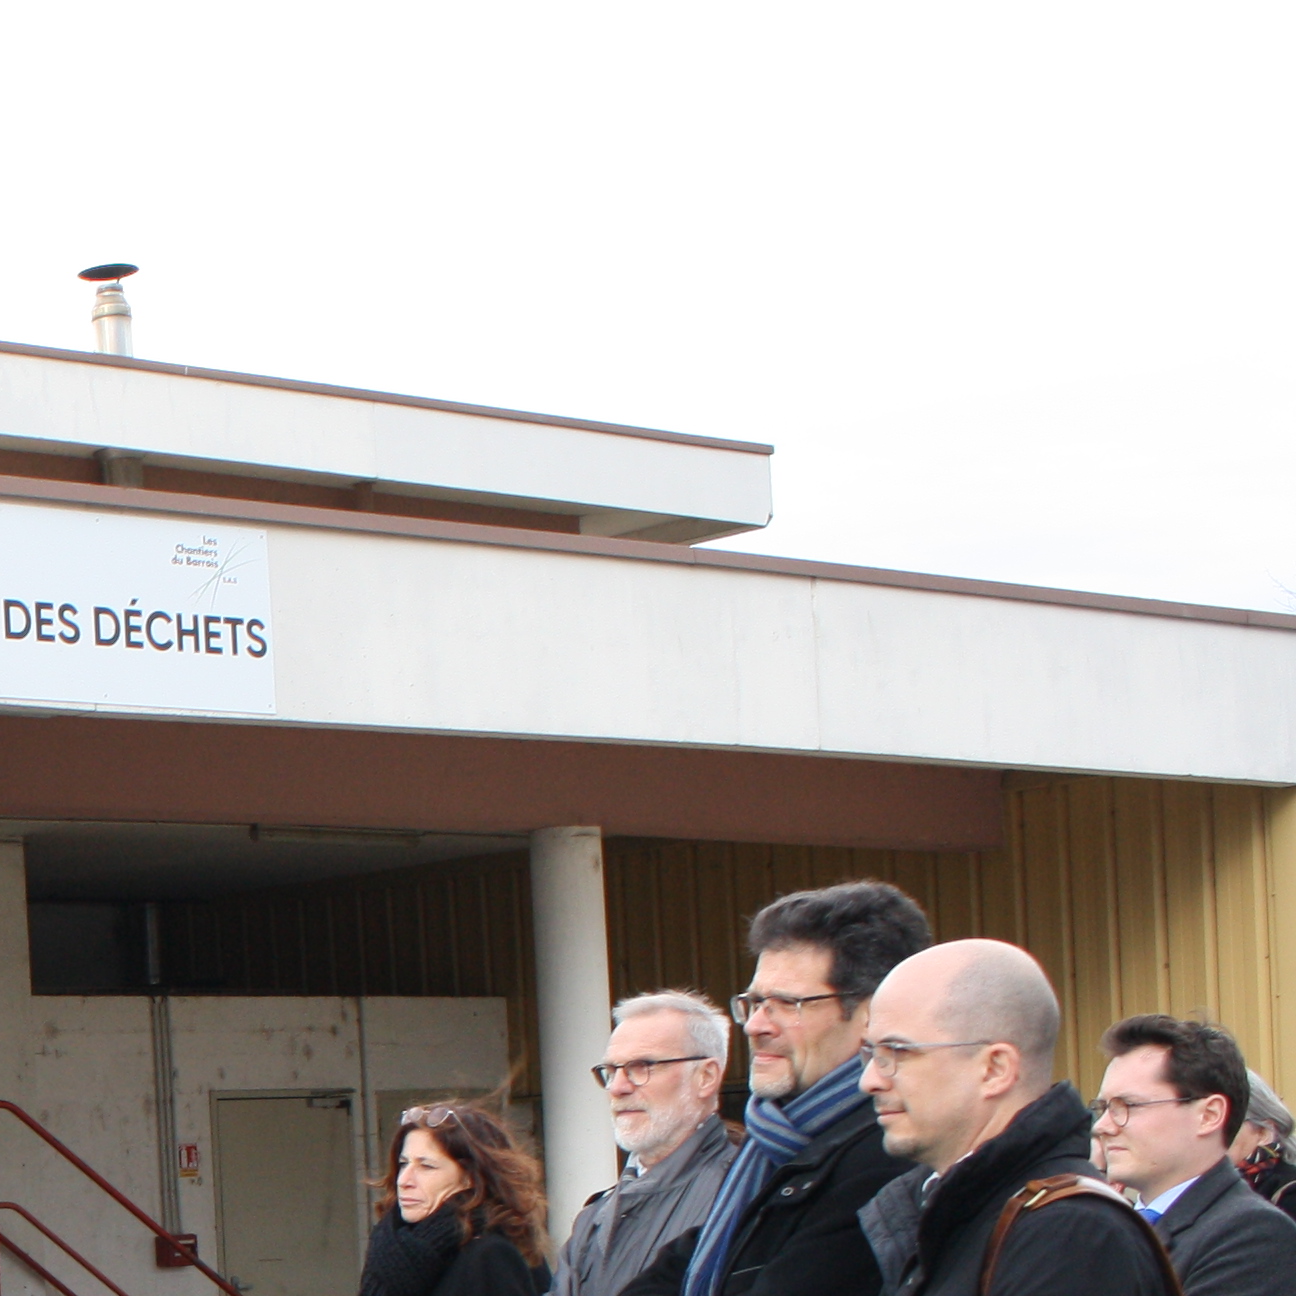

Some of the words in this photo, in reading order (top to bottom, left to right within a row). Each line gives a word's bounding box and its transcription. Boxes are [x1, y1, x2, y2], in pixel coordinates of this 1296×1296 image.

[202, 535, 218, 546] Les
[175, 543, 218, 557] Chantiers
[186, 555, 219, 568] Barrois
[3, 598, 81, 645] DES
[93, 598, 268, 659] DÉCHETS
